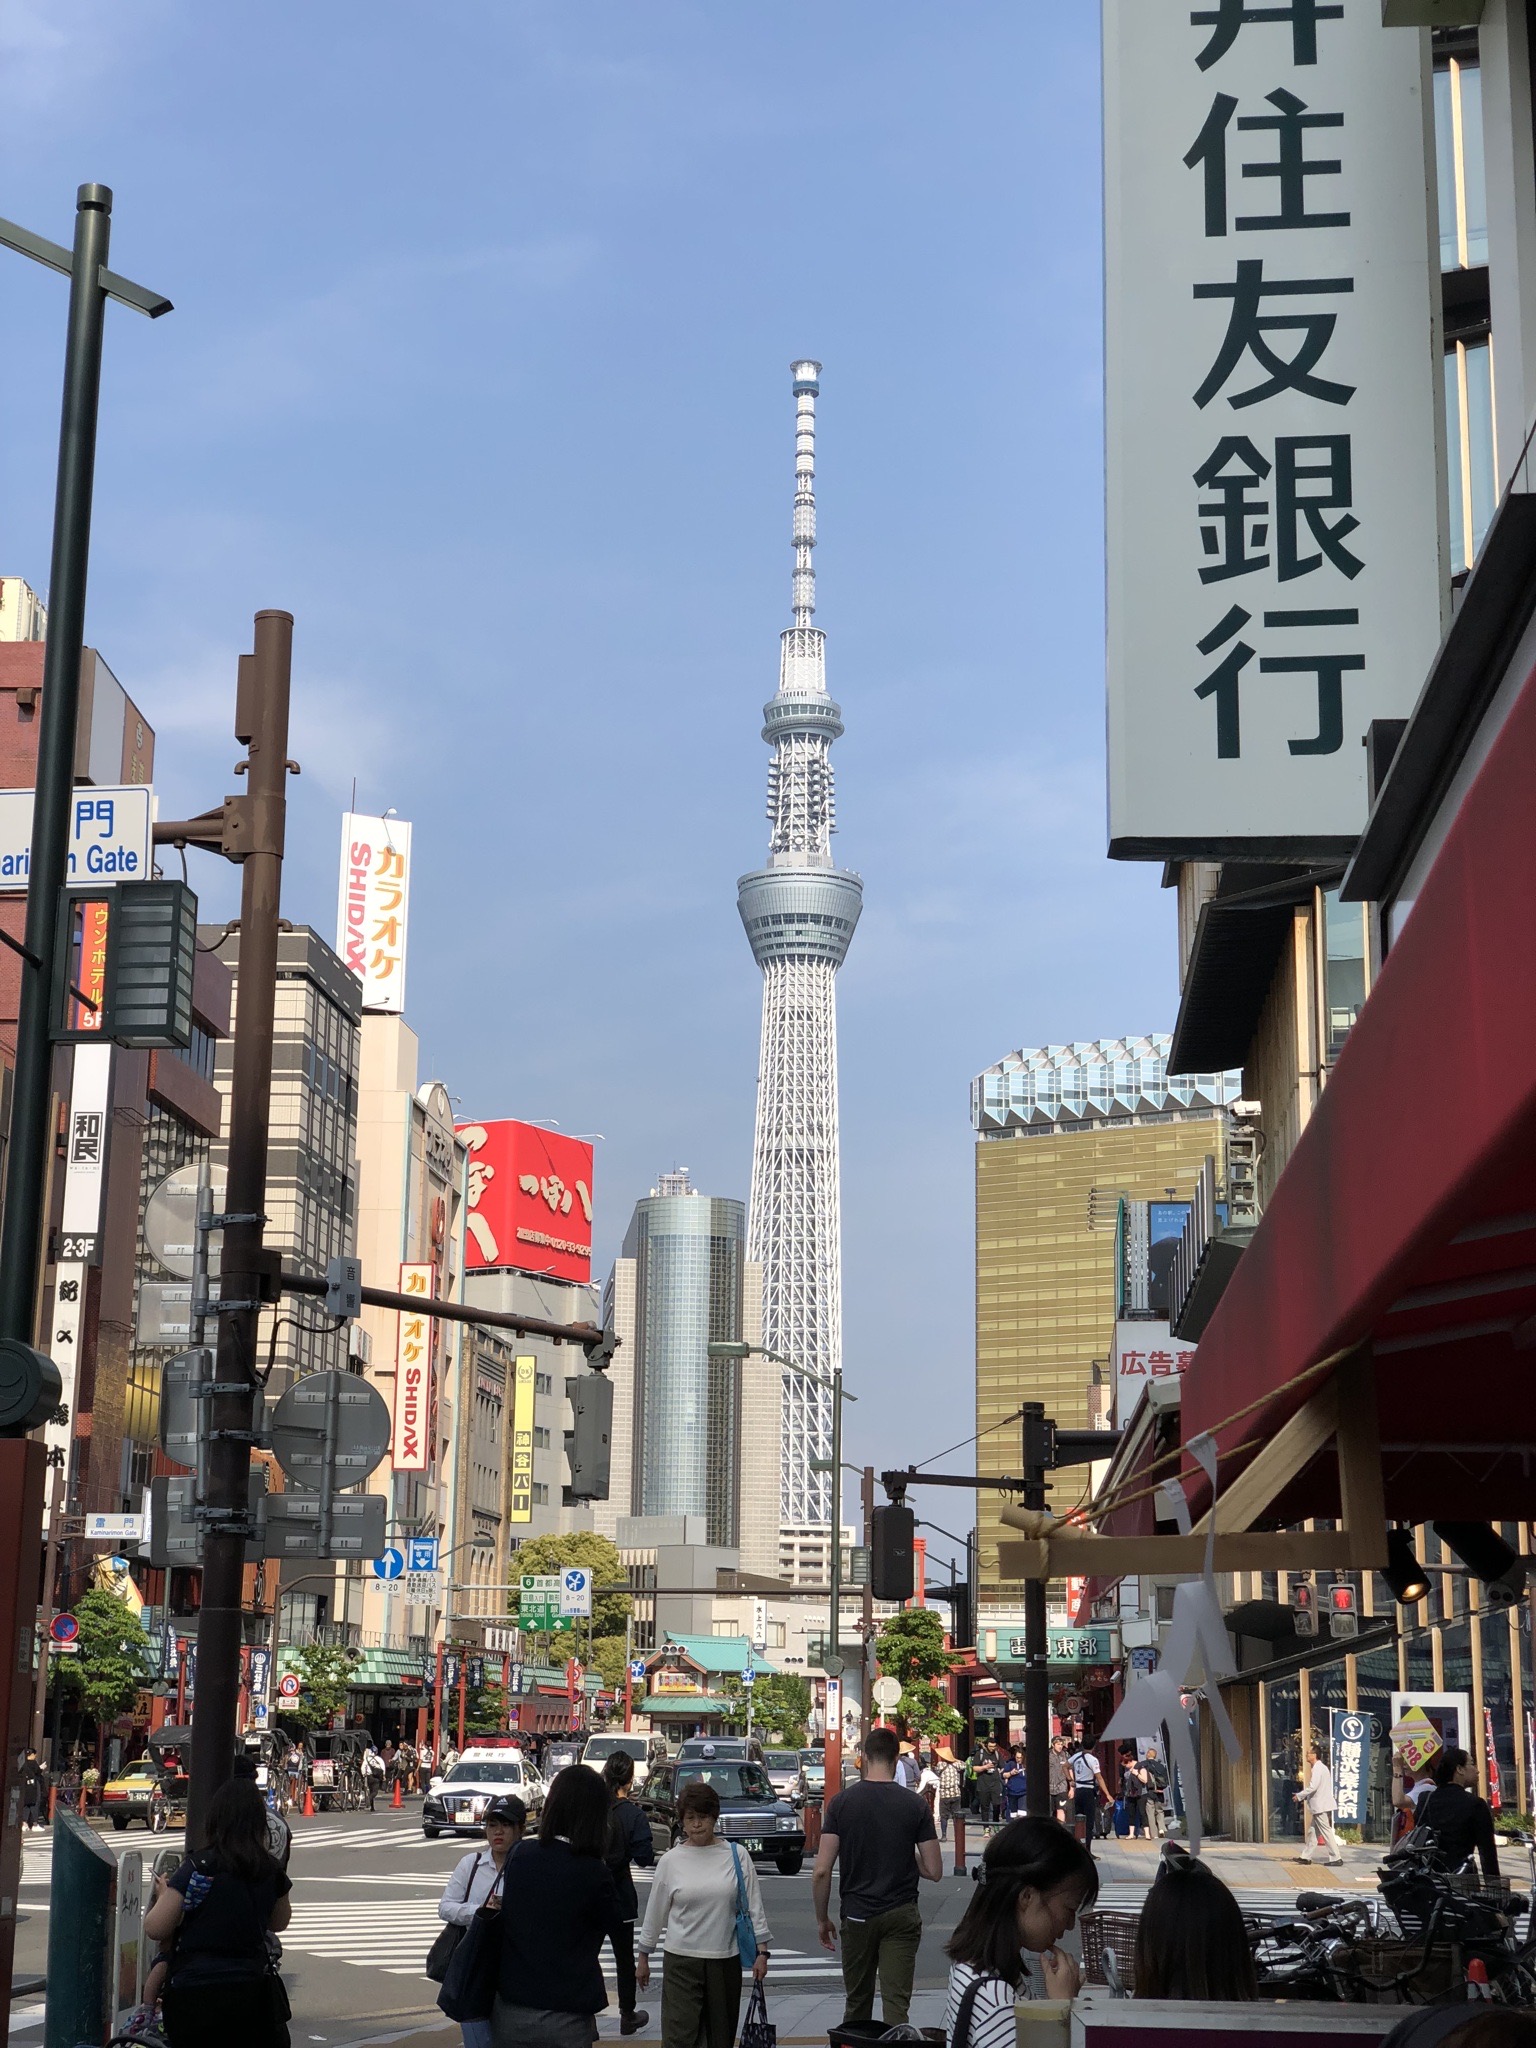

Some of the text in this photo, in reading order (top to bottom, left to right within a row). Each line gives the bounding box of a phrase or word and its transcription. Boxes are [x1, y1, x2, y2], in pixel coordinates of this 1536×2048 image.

[87, 844, 138, 873] Gate
[346, 841, 372, 977] SHIDAX
[370, 846, 404, 980] カラオケ
[73, 1115, 99, 1161] 和民
[518, 1174, 592, 1222] つぼ八
[403, 1272, 426, 1362] カオケ
[402, 1368, 421, 1459] SHIDAX
[515, 1433, 531, 1510] 神谷バー
[1010, 1636, 1097, 1656] 雷東部
